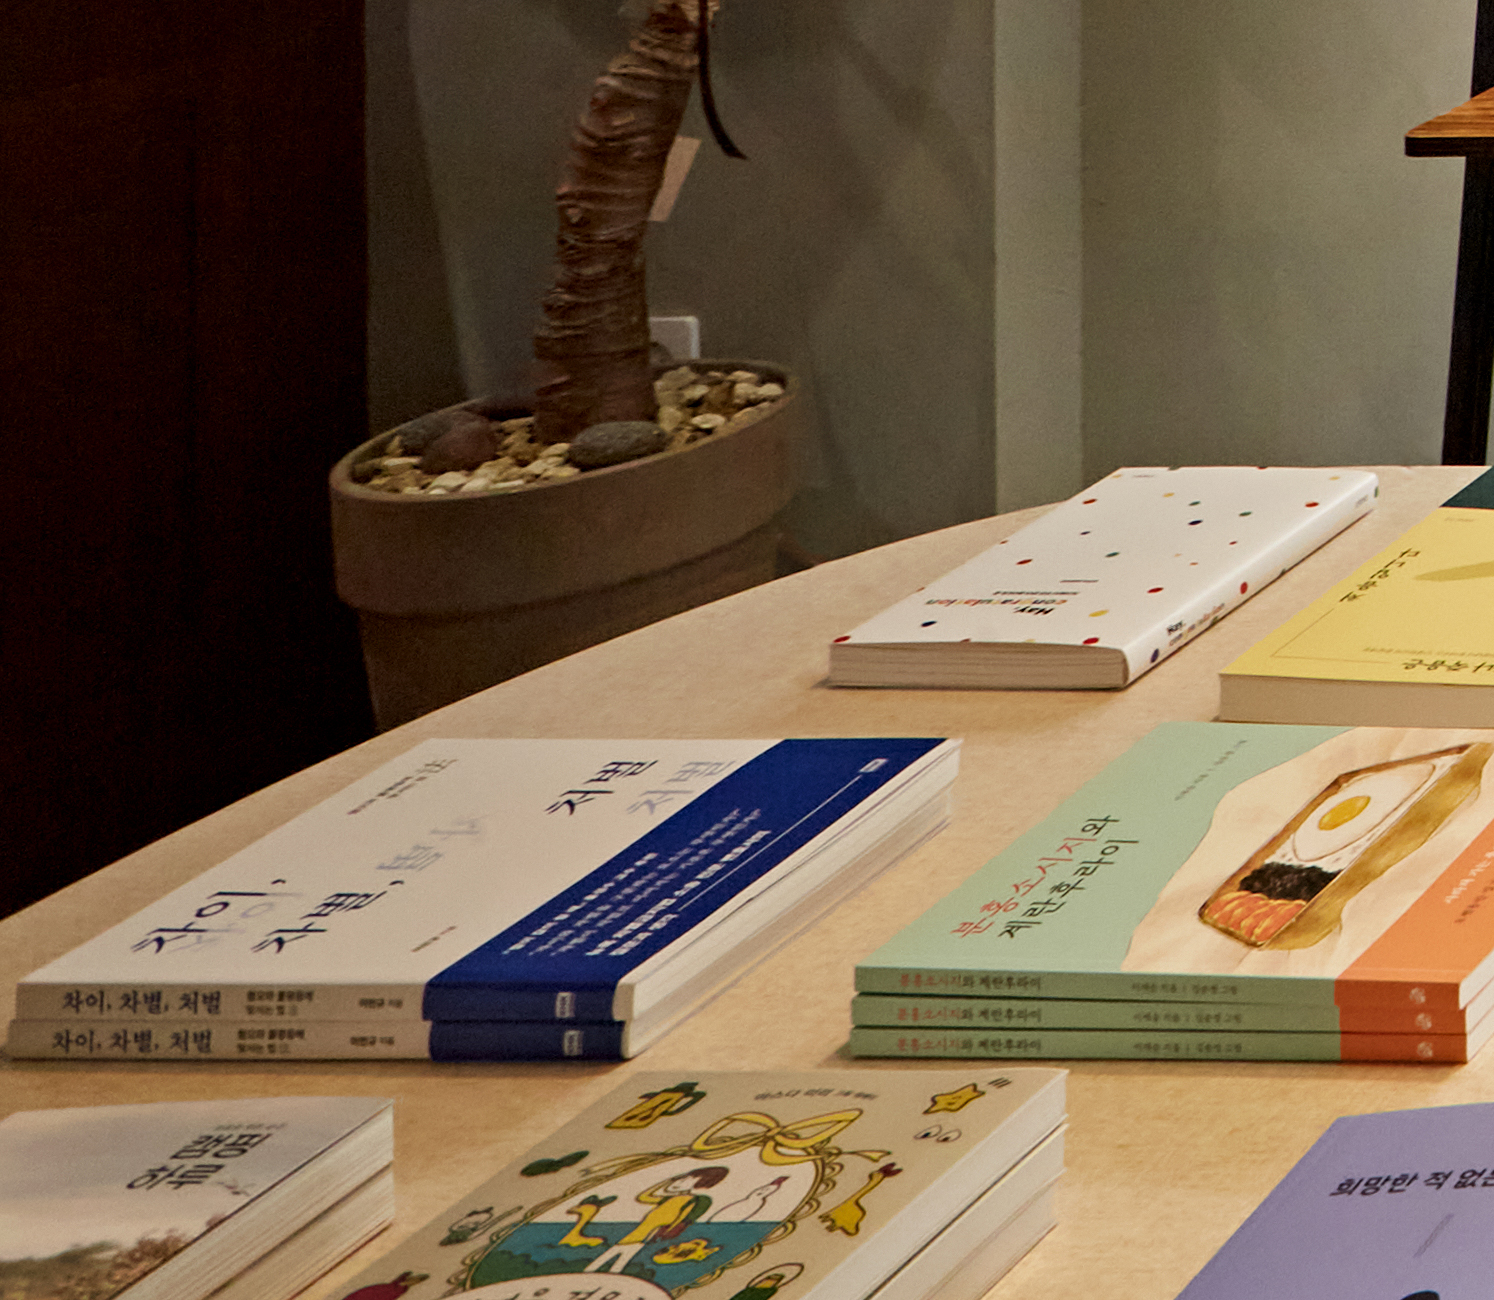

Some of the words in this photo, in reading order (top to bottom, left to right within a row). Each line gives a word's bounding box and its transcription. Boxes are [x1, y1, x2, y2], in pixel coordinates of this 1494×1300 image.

[1402, 658, 1469, 672] 죽음은
[545, 760, 659, 816] 처벌
[951, 814, 1121, 938] 분홍소시지와
[997, 839, 1140, 939] 계란후라이
[133, 878, 287, 954] 차이,
[253, 879, 405, 953] 차별,
[62, 990, 112, 1016] 차이,
[118, 990, 170, 1015] 차별,
[178, 990, 222, 1016] 처벌
[52, 1030, 101, 1055] 차이,
[110, 1029, 160, 1054] 차별,
[170, 1029, 213, 1055] 처벌
[1329, 1172, 1419, 1197] 희망한
[1423, 1170, 1454, 1191] 적
